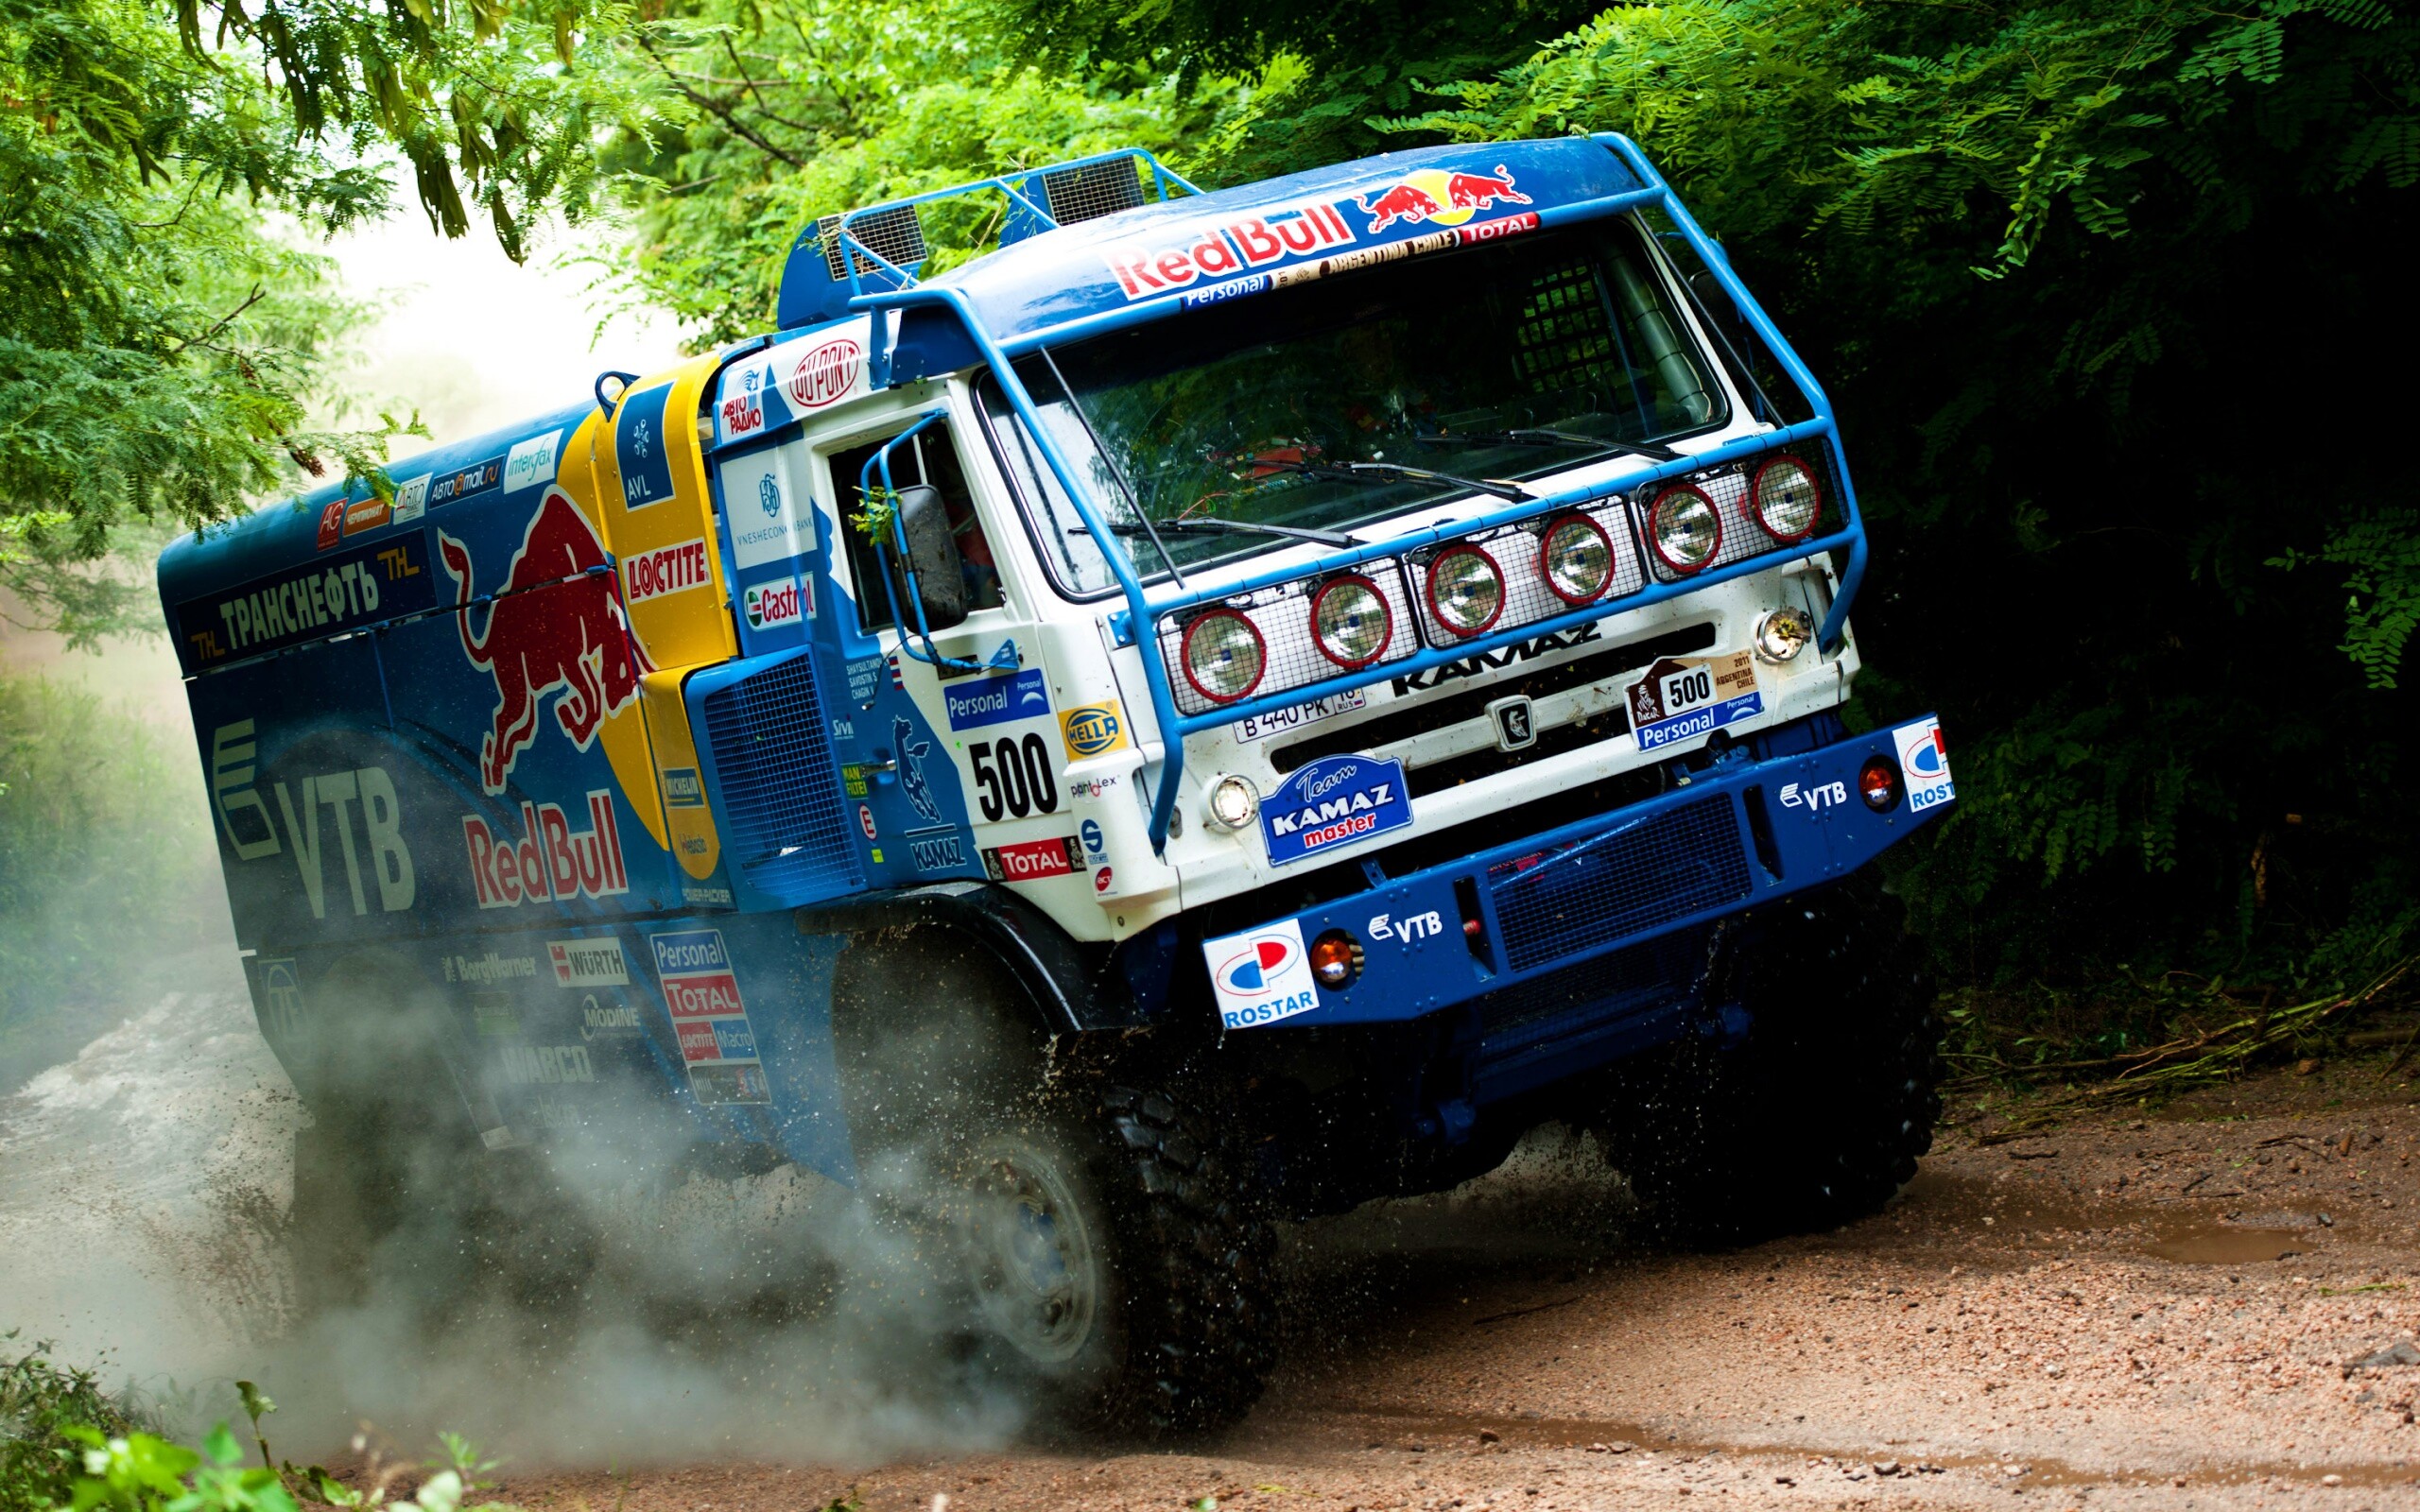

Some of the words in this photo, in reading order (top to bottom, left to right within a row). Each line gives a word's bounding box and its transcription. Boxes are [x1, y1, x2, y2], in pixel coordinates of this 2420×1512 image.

[1467, 216, 1535, 241] TOTAL
[1328, 242, 1409, 274] ARGENTINA
[1414, 231, 1452, 253] CHILE
[1187, 275, 1265, 305] Personal
[508, 438, 553, 482] interfax
[628, 475, 651, 500] AVL
[320, 502, 343, 534] AG
[737, 517, 813, 546] VNESHECONBANK
[628, 541, 705, 599] LOCTITE
[219, 561, 378, 650] ТРАНСНЕФТЬ
[846, 657, 883, 676] SHAYSULTANO
[1391, 622, 1603, 697] KAMAZ
[1735, 656, 1750, 667] 2011
[1016, 678, 1042, 692] Personal
[1668, 672, 1710, 708] 500
[1716, 668, 1753, 686] ARGENTINA
[1737, 677, 1755, 689] CHILE
[949, 685, 1008, 718] Personal
[1338, 701, 1354, 710] RUS
[1726, 695, 1755, 710] Personal
[1068, 715, 1118, 742] HELLA
[1643, 708, 1715, 747] Personal
[846, 781, 868, 796] FILTE
[968, 732, 1058, 822] 500
[1296, 763, 1357, 803] Team
[1272, 783, 1393, 837] KAMAZ
[1804, 781, 1847, 811] VTB
[861, 810, 875, 834] E
[1303, 811, 1377, 849] master
[273, 767, 415, 919] VTB
[909, 836, 967, 871] KAMAZ
[1002, 851, 1067, 874] TOTAL
[1394, 911, 1443, 943] VTB
[569, 950, 624, 976] WÜRTH
[657, 935, 724, 968] Personal
[456, 953, 536, 985] BorgWarner
[666, 984, 739, 1012] TOTAL
[1224, 991, 1314, 1028] ROSTAR
[584, 1005, 640, 1028] MODINE
[682, 1032, 716, 1049] LOCTITE
[717, 1030, 752, 1048] Macro
[499, 1045, 595, 1083] WABCO
